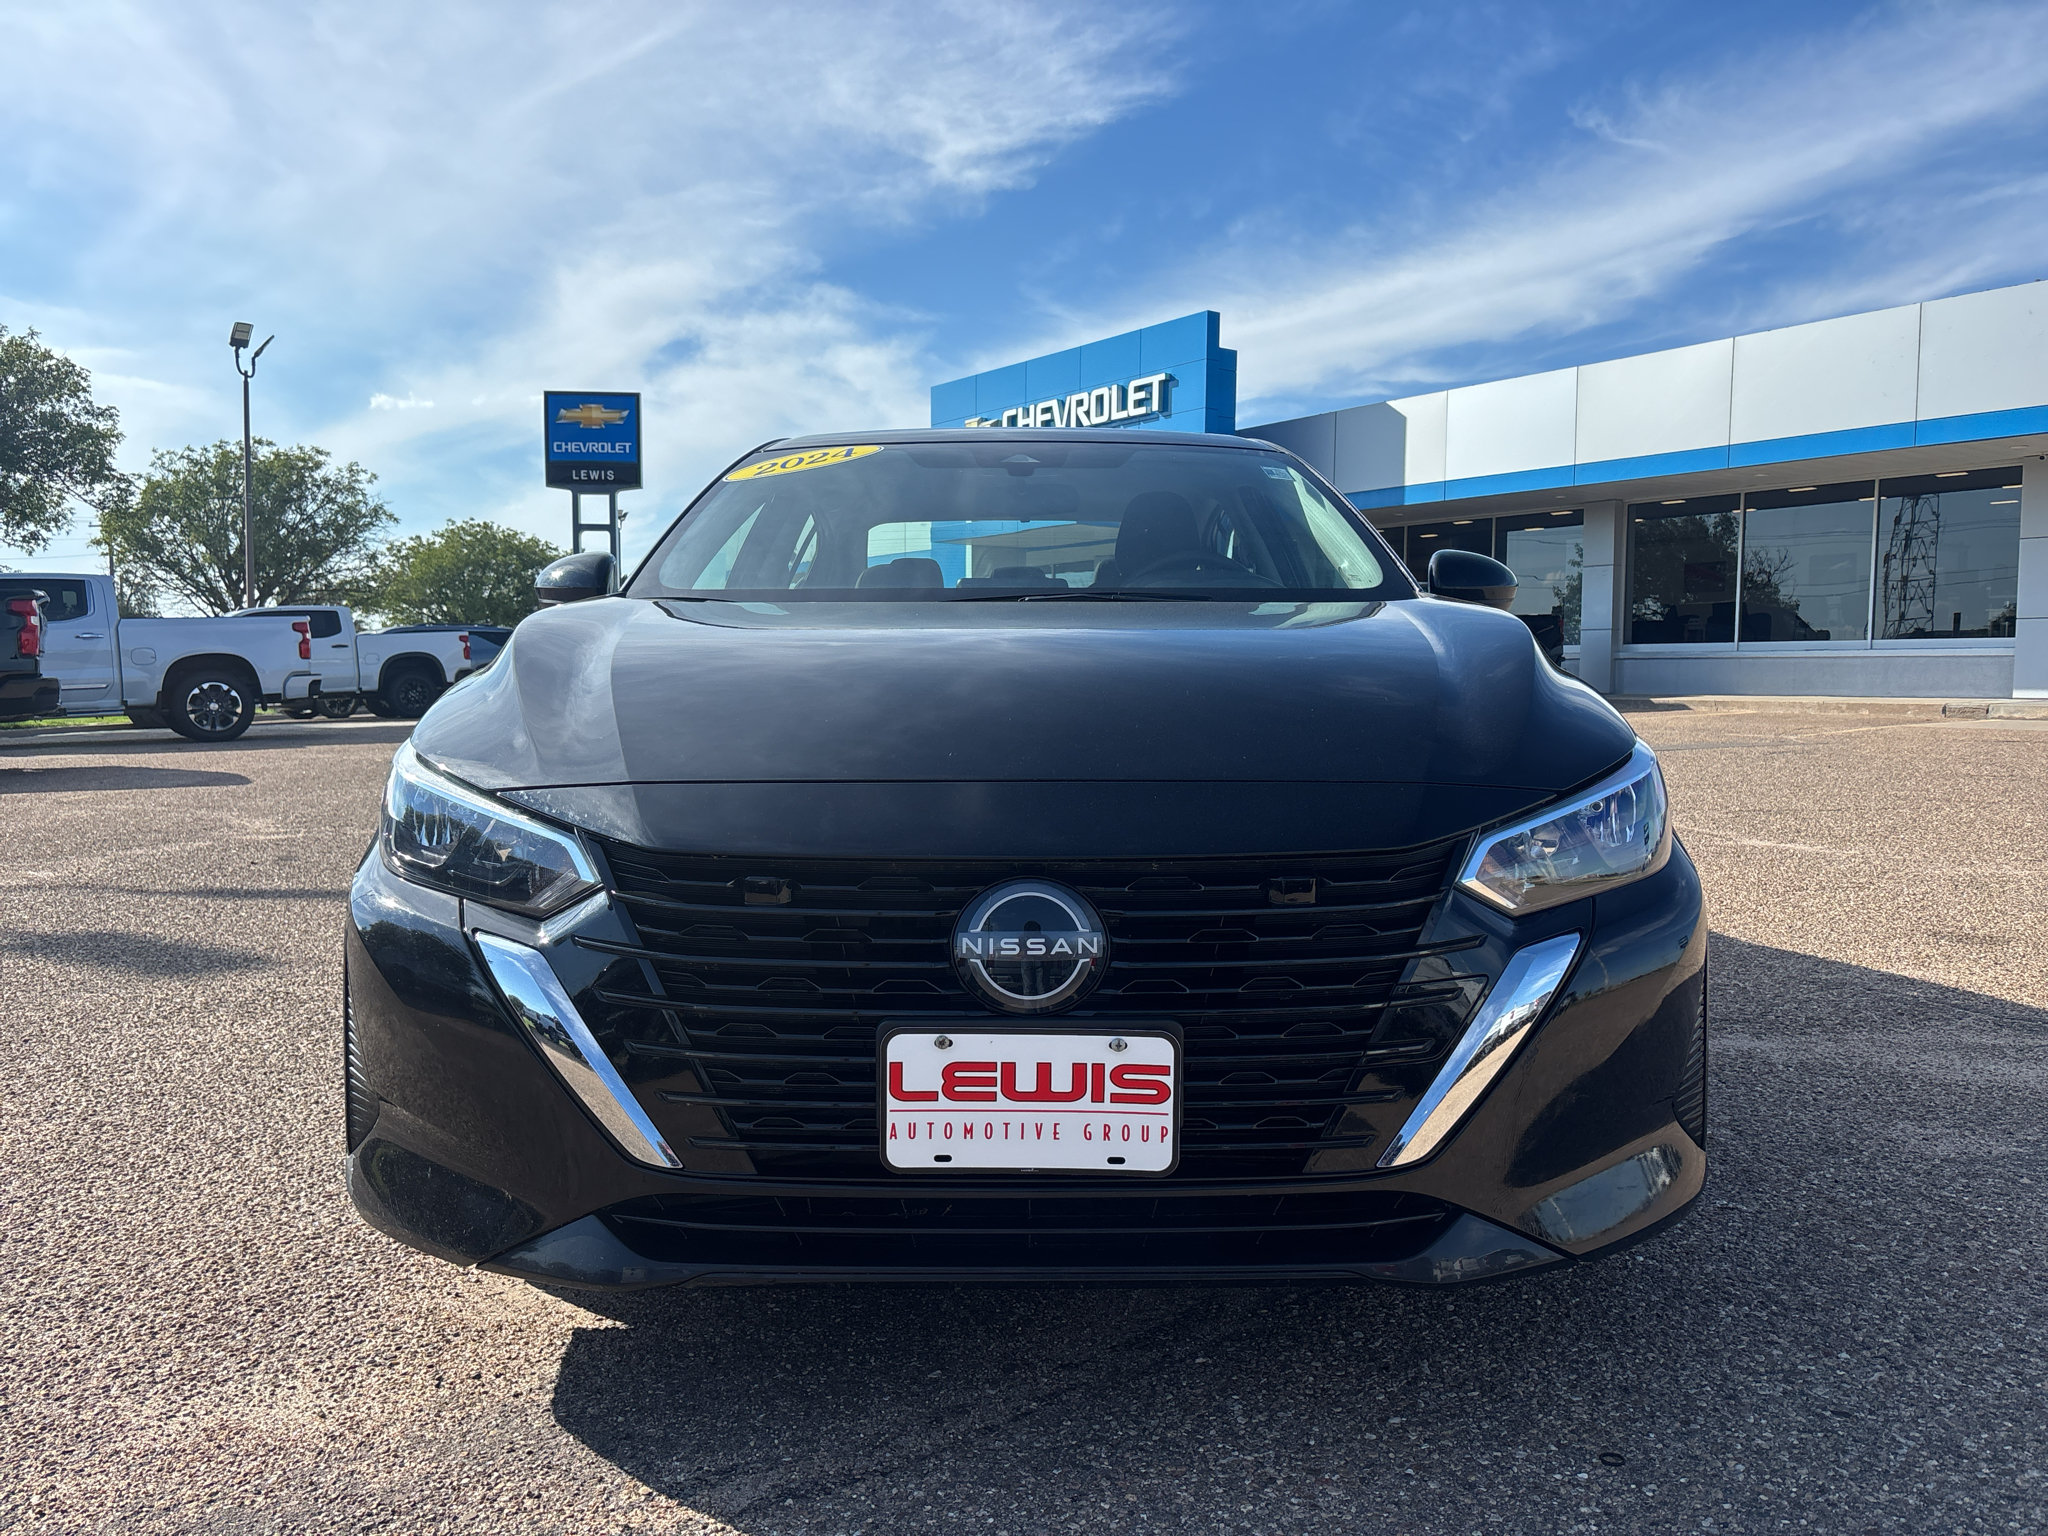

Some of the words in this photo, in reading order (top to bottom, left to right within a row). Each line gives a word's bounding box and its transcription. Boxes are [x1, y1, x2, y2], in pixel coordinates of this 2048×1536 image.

[1002, 373, 1168, 428] CHEVROLET
[553, 441, 632, 454] CHEVROLET
[753, 447, 858, 477] 2024
[572, 470, 615, 481] LEWIS
[961, 937, 1098, 956] NISSAN
[889, 1061, 1172, 1105] LEWIS
[889, 1122, 1061, 1141] AUTOMOTIVE
[1083, 1123, 1169, 1143] GROUP
